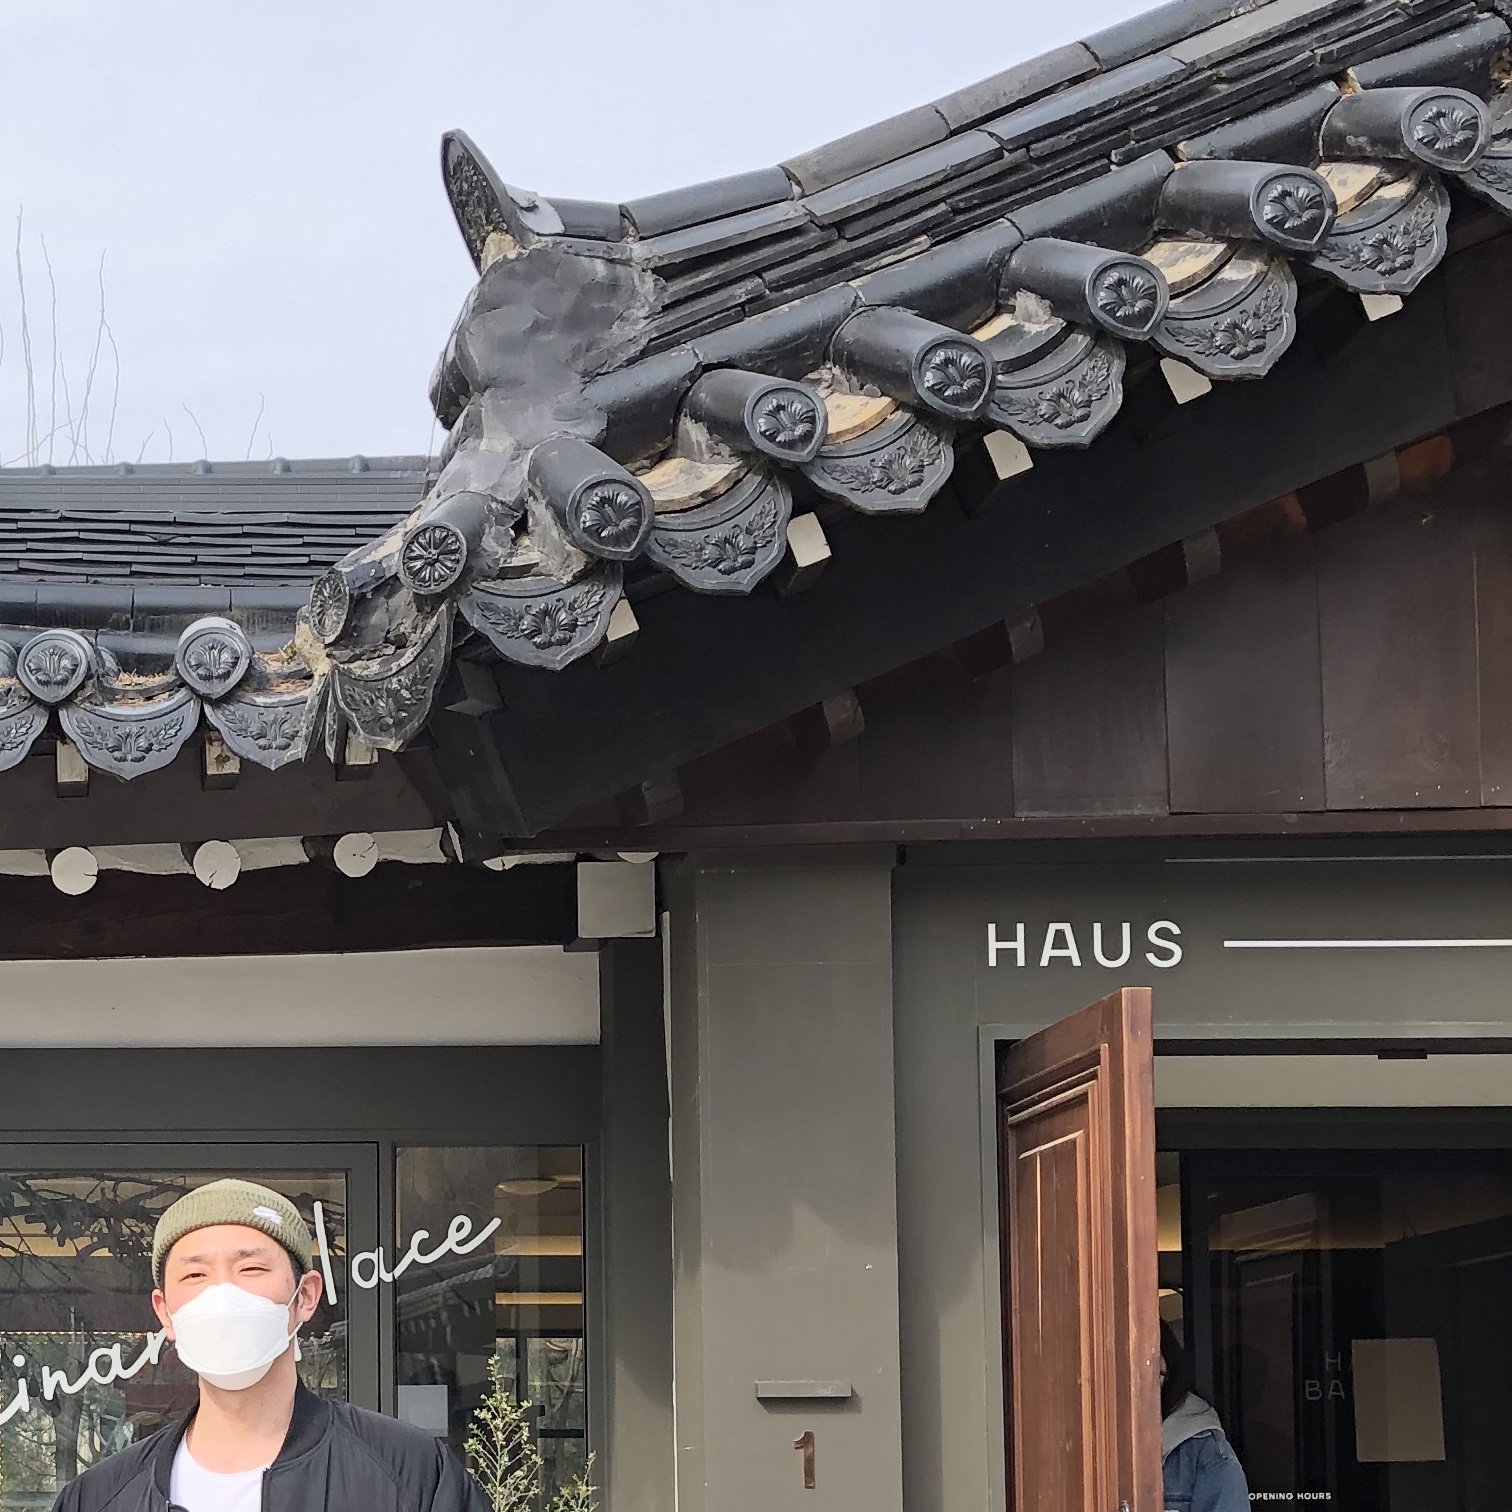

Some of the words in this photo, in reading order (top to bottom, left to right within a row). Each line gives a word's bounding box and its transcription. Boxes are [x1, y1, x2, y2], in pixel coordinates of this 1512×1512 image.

[987, 920, 1184, 968] HAUS
[293, 1201, 502, 1362] lace
[793, 1430, 816, 1490] 1
[1248, 1491, 1294, 1501] OPENING
[1296, 1491, 1332, 1501] HOURS
